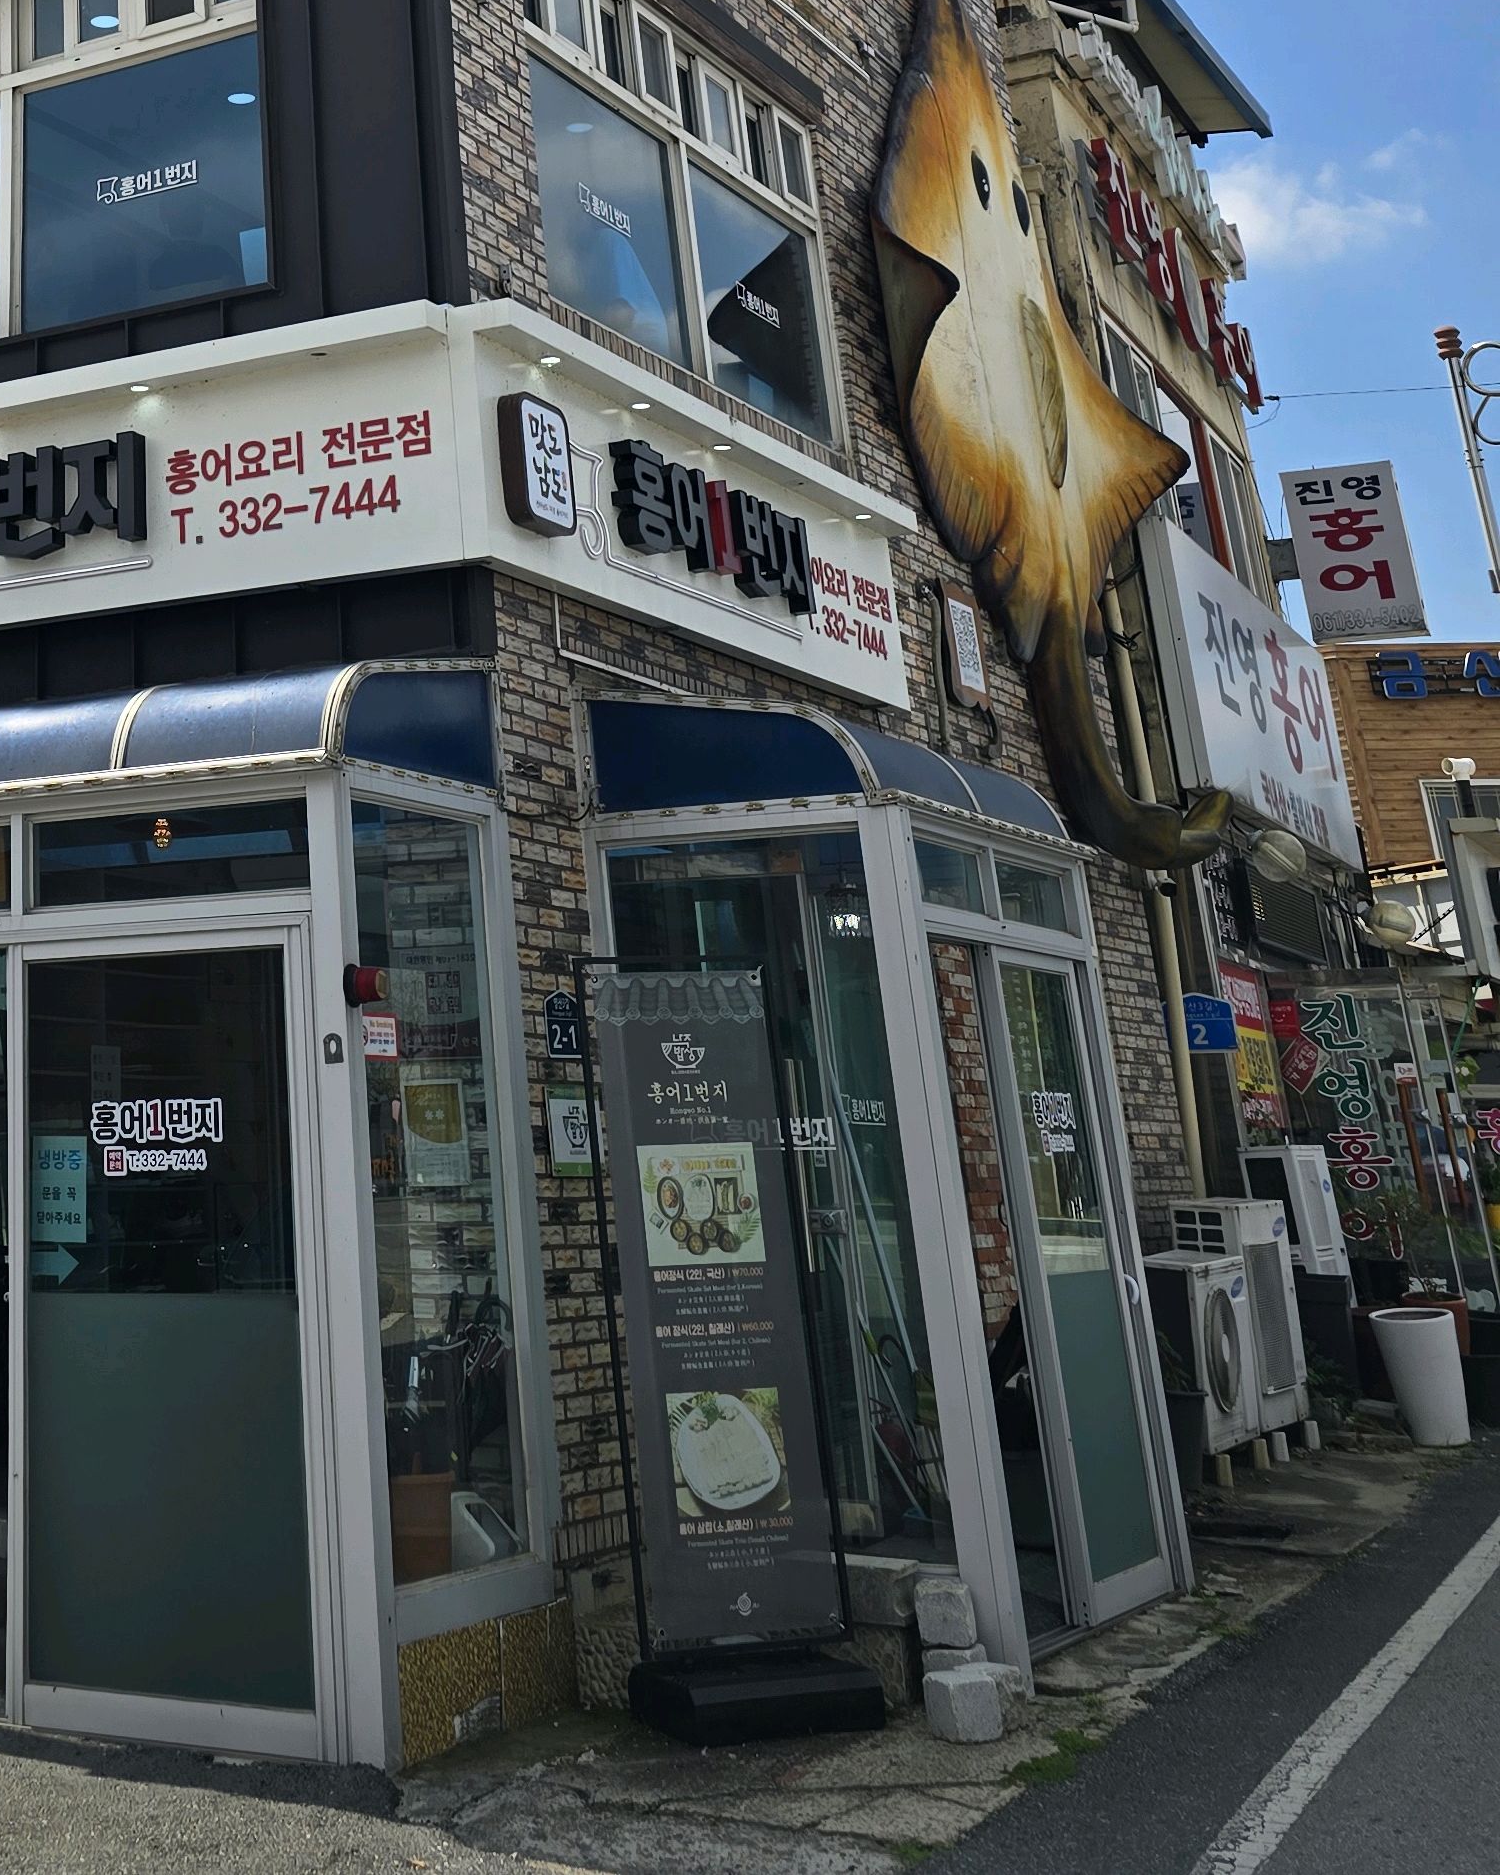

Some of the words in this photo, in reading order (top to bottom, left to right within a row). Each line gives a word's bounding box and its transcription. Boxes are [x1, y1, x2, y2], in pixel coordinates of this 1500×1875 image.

[120, 160, 197, 194] 홍어1번지
[165, 431, 304, 496] 홍어요리
[321, 410, 433, 469] 전문점
[1295, 472, 1382, 506] 진영
[219, 474, 401, 539] 332-7444
[609, 439, 816, 615] 홍어1번지
[1308, 508, 1396, 600] 홍어
[811, 557, 850, 606] 어요리
[852, 575, 892, 623] 전문점
[822, 605, 887, 660] 332-7444
[1312, 605, 1421, 633] 061)334-5402
[1197, 591, 1267, 734] 진영
[1264, 628, 1338, 782] 홍어
[551, 1024, 577, 1049] 2-1
[1192, 1024, 1209, 1045] 2
[647, 1080, 728, 1105] 홍어1번지
[90, 1098, 223, 1144] 홍어1번지
[38, 1149, 83, 1171] 냉방중
[42, 1186, 62, 1201] 문을
[66, 1186, 77, 1202] 꼭
[36, 1211, 82, 1225] 닫아주세요
